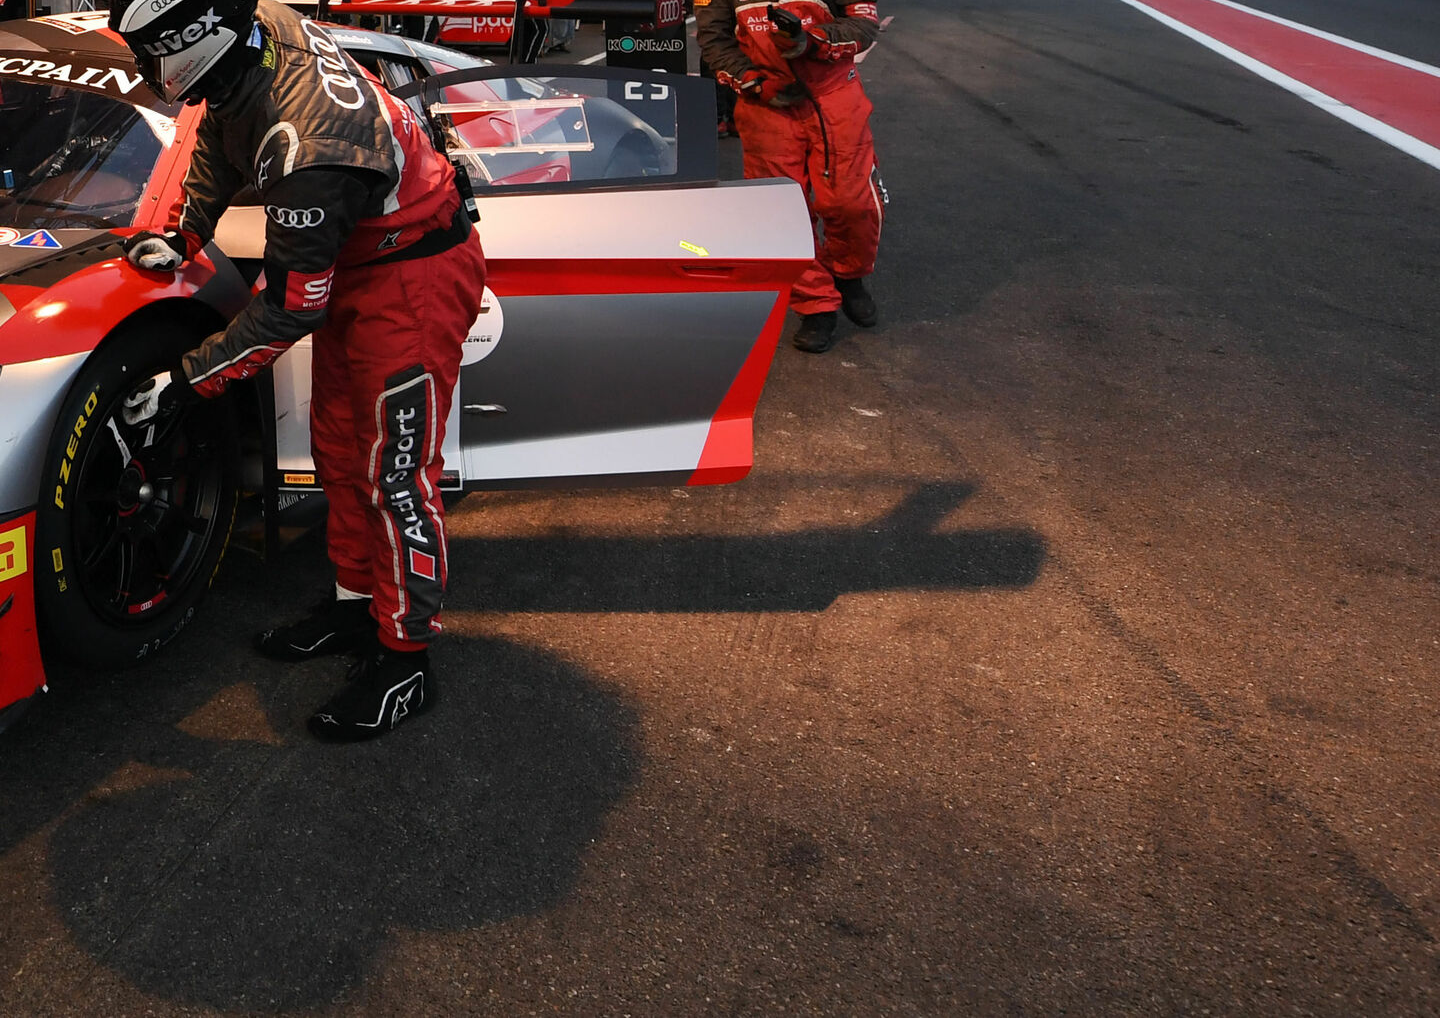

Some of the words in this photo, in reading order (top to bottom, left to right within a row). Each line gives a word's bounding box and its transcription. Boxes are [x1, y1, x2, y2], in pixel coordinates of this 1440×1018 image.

[143, 6, 223, 57] uvex
[747, 16, 768, 25] Aud
[748, 23, 769, 33] Top
[608, 35, 684, 54] KONRAD
[385, 407, 417, 484] Sport
[390, 489, 429, 544] Audi
